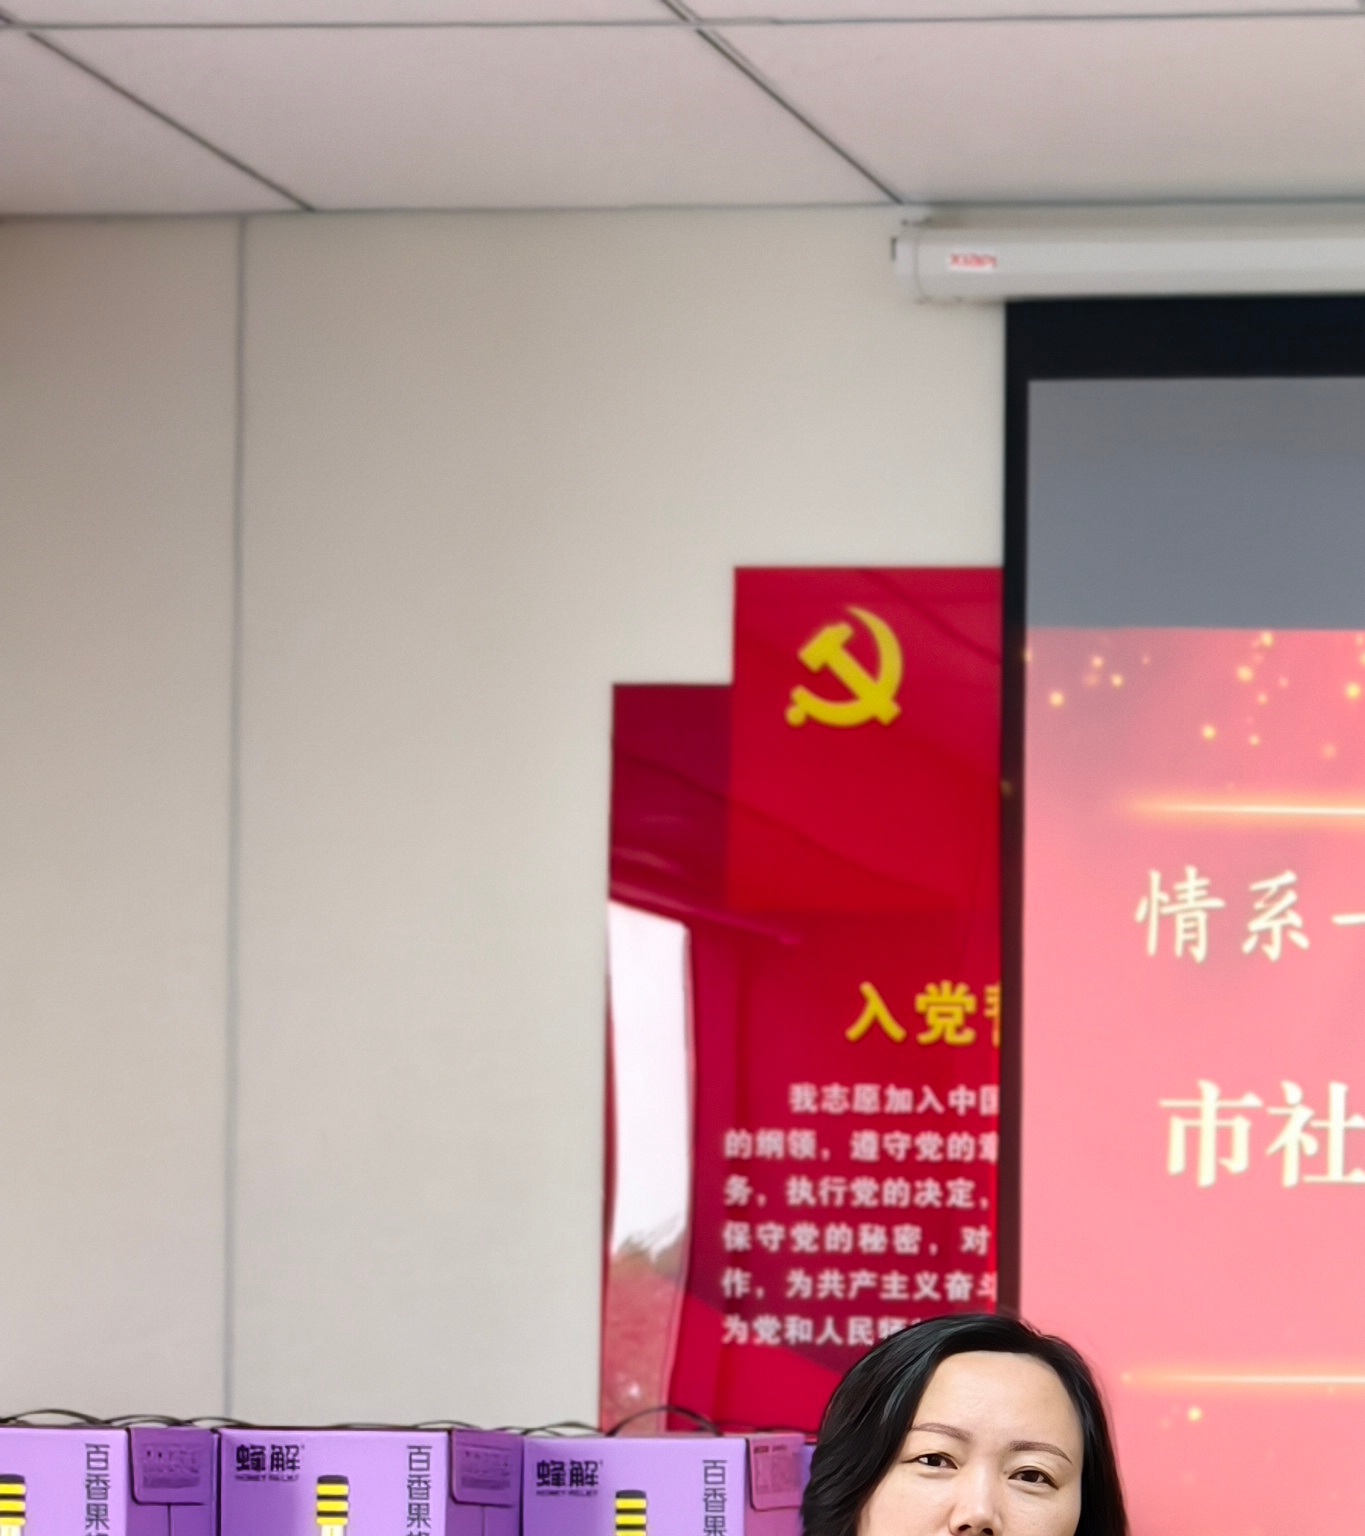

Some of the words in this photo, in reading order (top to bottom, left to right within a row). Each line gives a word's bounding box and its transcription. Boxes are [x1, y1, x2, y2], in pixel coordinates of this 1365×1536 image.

[845, 980, 999, 1048] 入党
[788, 1082, 999, 1116] 我志愿加入中国
[721, 1313, 922, 1347] 为党和人民牺
[236, 1444, 301, 1472] 蜂解
[536, 1459, 599, 1487] 蜂解
